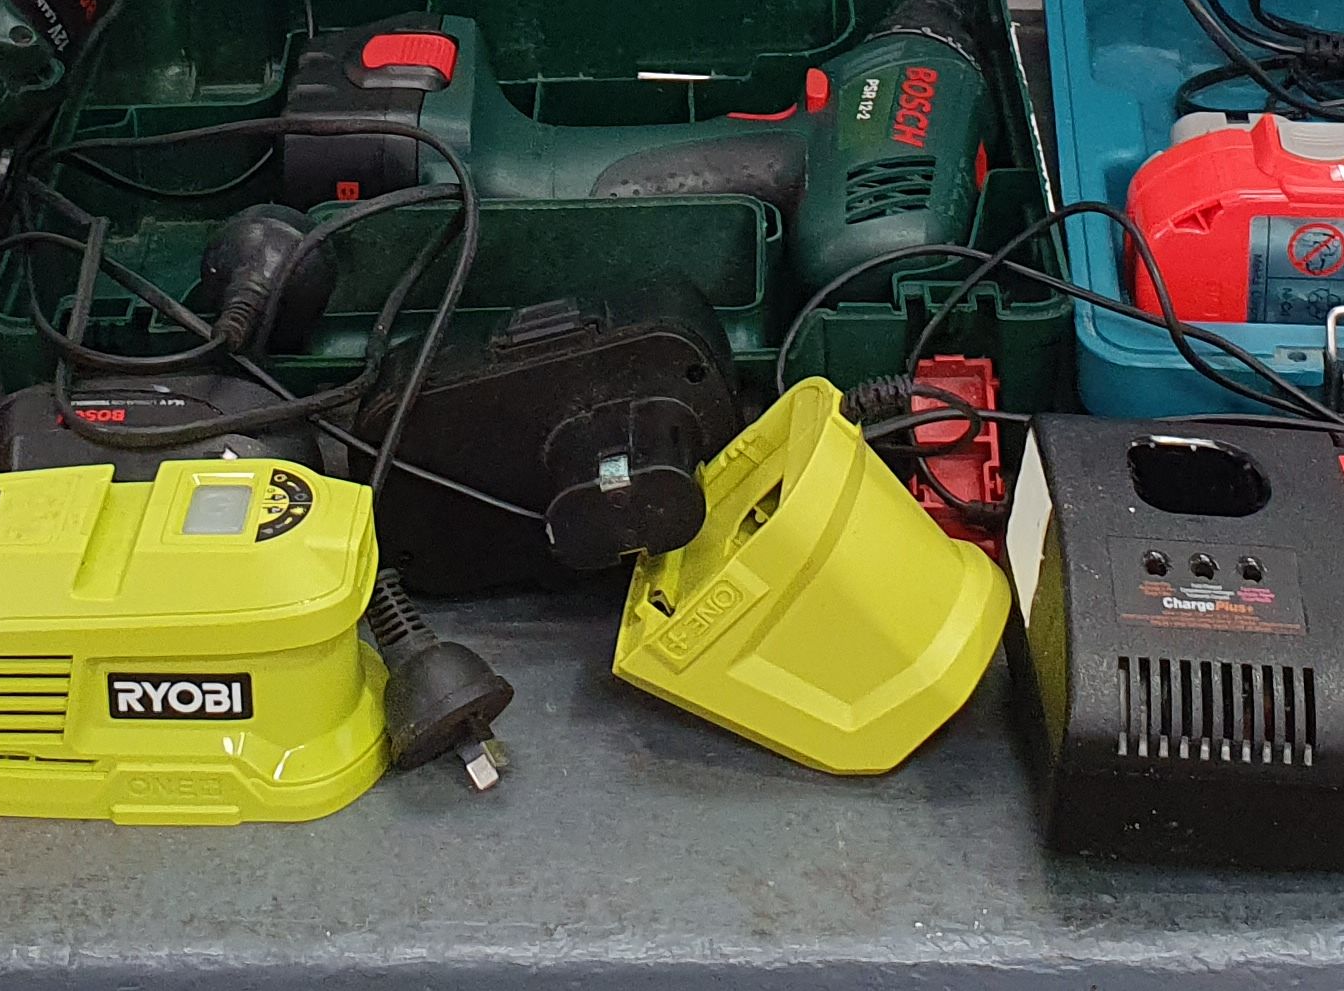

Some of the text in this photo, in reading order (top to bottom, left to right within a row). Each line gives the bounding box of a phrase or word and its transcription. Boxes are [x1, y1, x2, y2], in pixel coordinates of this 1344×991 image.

[48, 24, 69, 51] 12V
[856, 79, 880, 120] PSR 12-2
[892, 67, 938, 148] BOSCH
[57, 410, 125, 424] BOS
[113, 681, 242, 713] RYOBI
